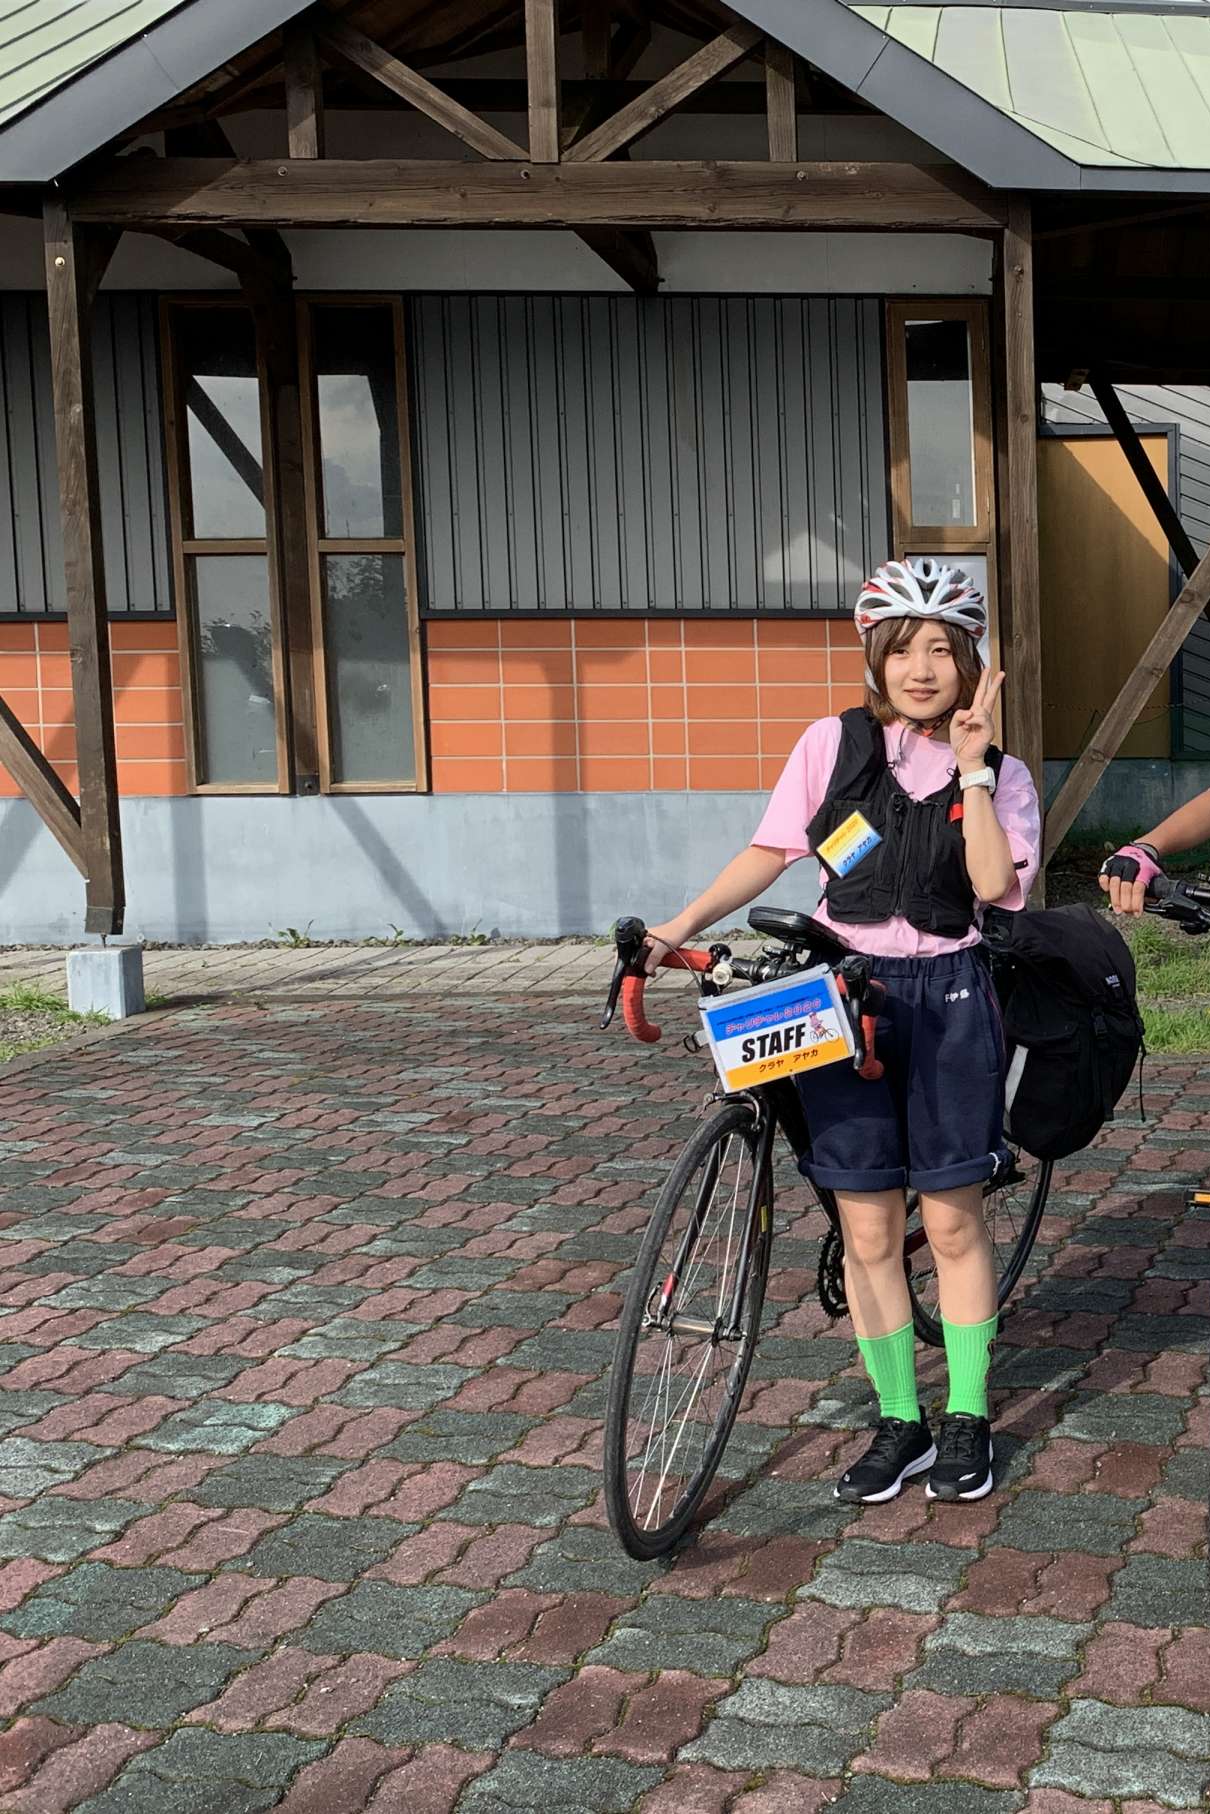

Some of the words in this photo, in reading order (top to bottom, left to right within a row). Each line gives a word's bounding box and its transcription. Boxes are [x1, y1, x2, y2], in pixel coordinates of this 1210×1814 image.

[741, 1023, 806, 1063] STAFF
[759, 1058, 785, 1073] クラヤ
[793, 1049, 819, 1063] アヤカ
